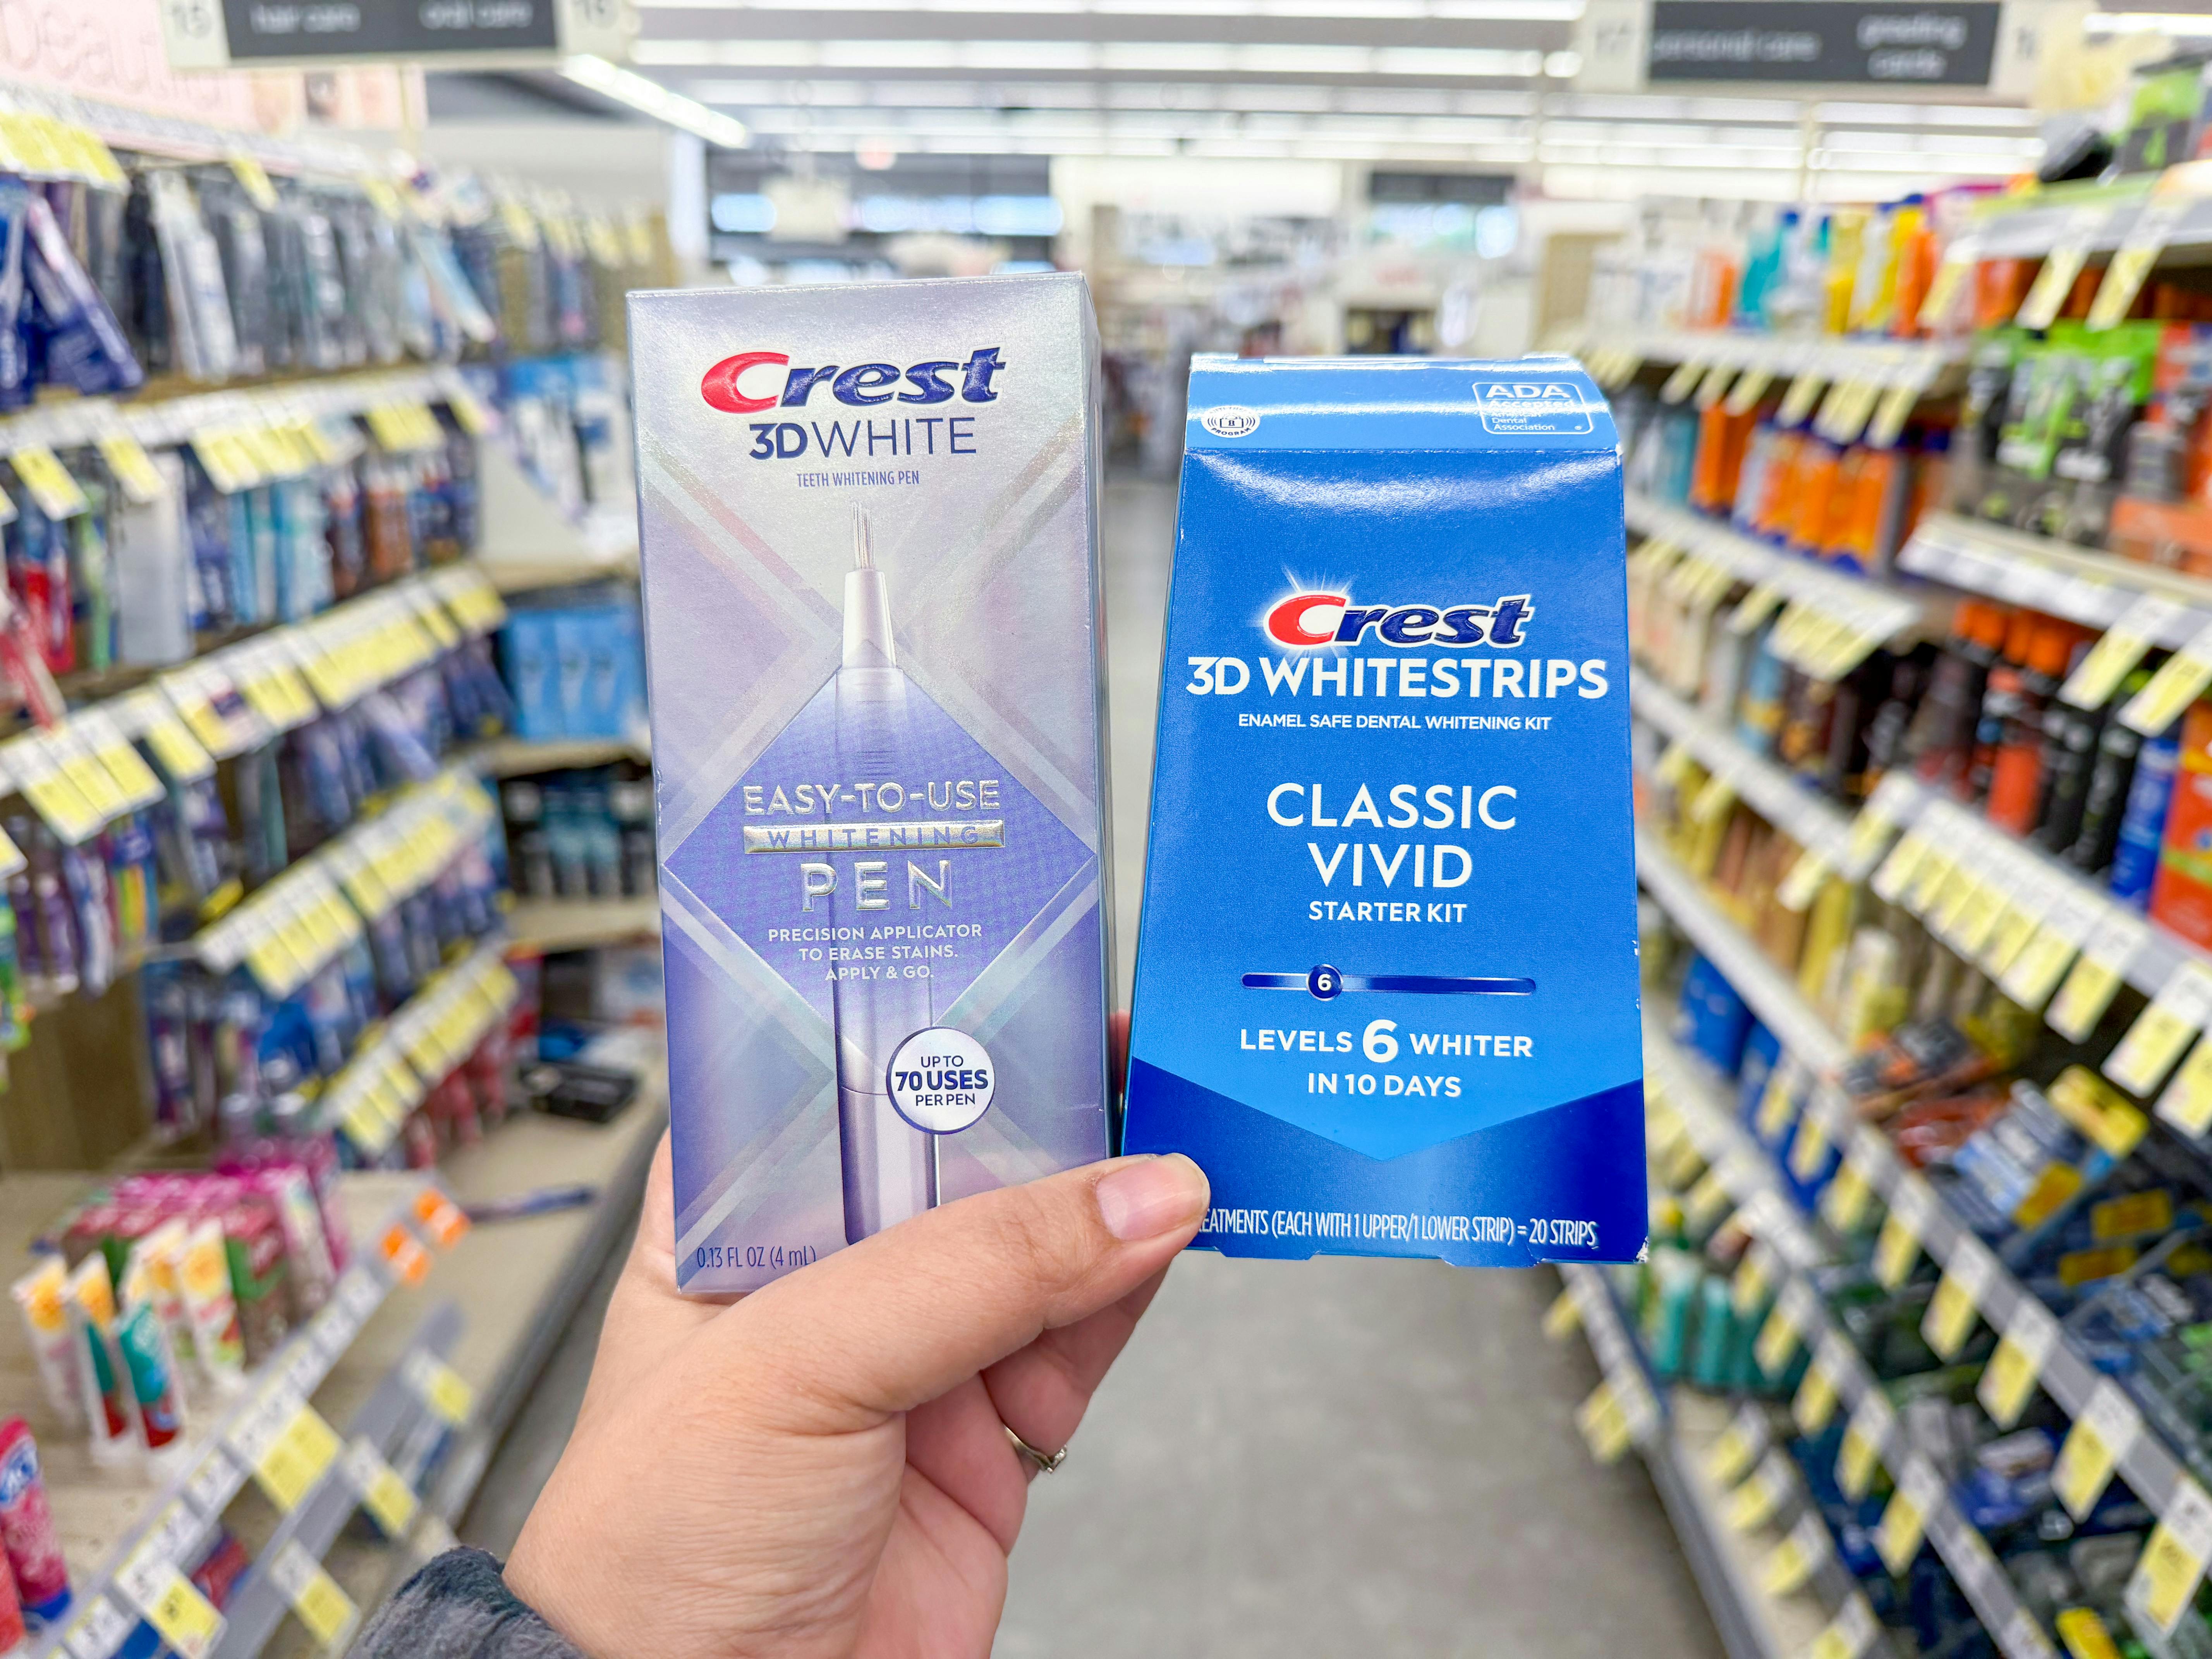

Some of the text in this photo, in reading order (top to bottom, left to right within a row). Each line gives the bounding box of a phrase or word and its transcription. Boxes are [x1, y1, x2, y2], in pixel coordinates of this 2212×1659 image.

[701, 347, 1005, 414] Crest
[1486, 385, 1571, 398] ADA
[749, 417, 976, 459] 3D WHITE
[1211, 428, 1251, 436] PROGRAM
[797, 471, 919, 487] TEETH WHITENING PEN
[1268, 594, 1530, 646] Crest
[1185, 656, 1608, 699] 3D WHITESTRIPS
[1239, 714, 1551, 730] ENAMEL SAFE DENTAL WHITENING KIT
[743, 780, 1000, 816] EASY-TO-USE
[1267, 782, 1517, 830] CLASSIC
[768, 826, 979, 849] WHITENING
[1307, 842, 1473, 888] VIVID
[802, 859, 953, 912] PEN
[1308, 901, 1467, 923] STARTER KIT
[769, 924, 982, 941] PRECISION APPLICATOR
[799, 945, 958, 961] TO ERASE STAINS.
[825, 965, 934, 981] APPLY & GO.
[1317, 974, 1331, 990] 6
[1240, 1019, 1533, 1063] LEVELS 6 WHITER
[921, 1055, 963, 1068] UP TO
[895, 1069, 988, 1091] 70 USES
[1307, 1072, 1462, 1097] IN 10 DAYS
[916, 1093, 975, 1106] PER PEN
[1199, 1208, 1597, 1246] EATMENTS (EACH WITH 1 UPPER/1 LOWER STRIP) = 20 STRIPS
[697, 1245, 816, 1269] 0.13 FL OZ (4 mL)
